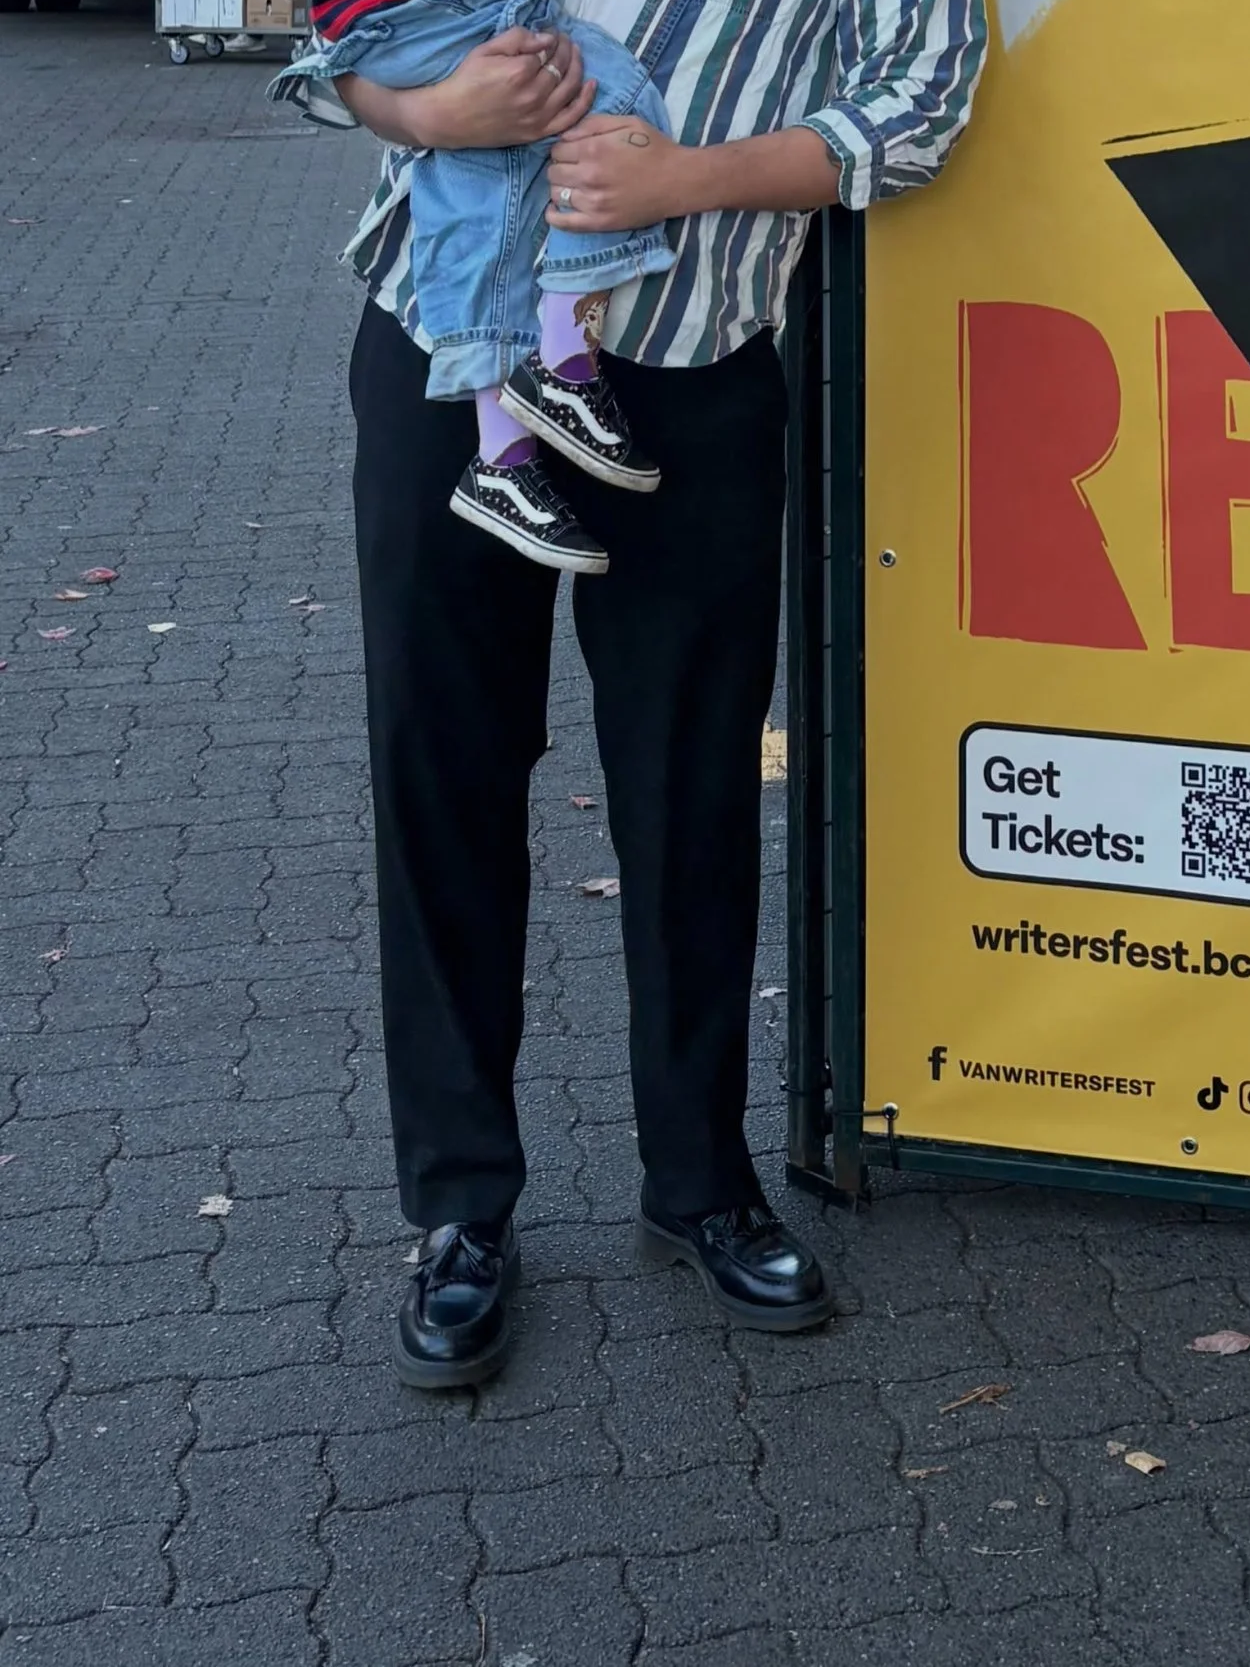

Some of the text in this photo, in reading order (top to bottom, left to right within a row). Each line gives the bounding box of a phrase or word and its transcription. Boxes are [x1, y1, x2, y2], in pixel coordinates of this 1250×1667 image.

[983, 755, 1061, 798] Get
[982, 812, 1145, 864] Tickets:
[958, 1059, 1156, 1098] VANWRITERSFEST
